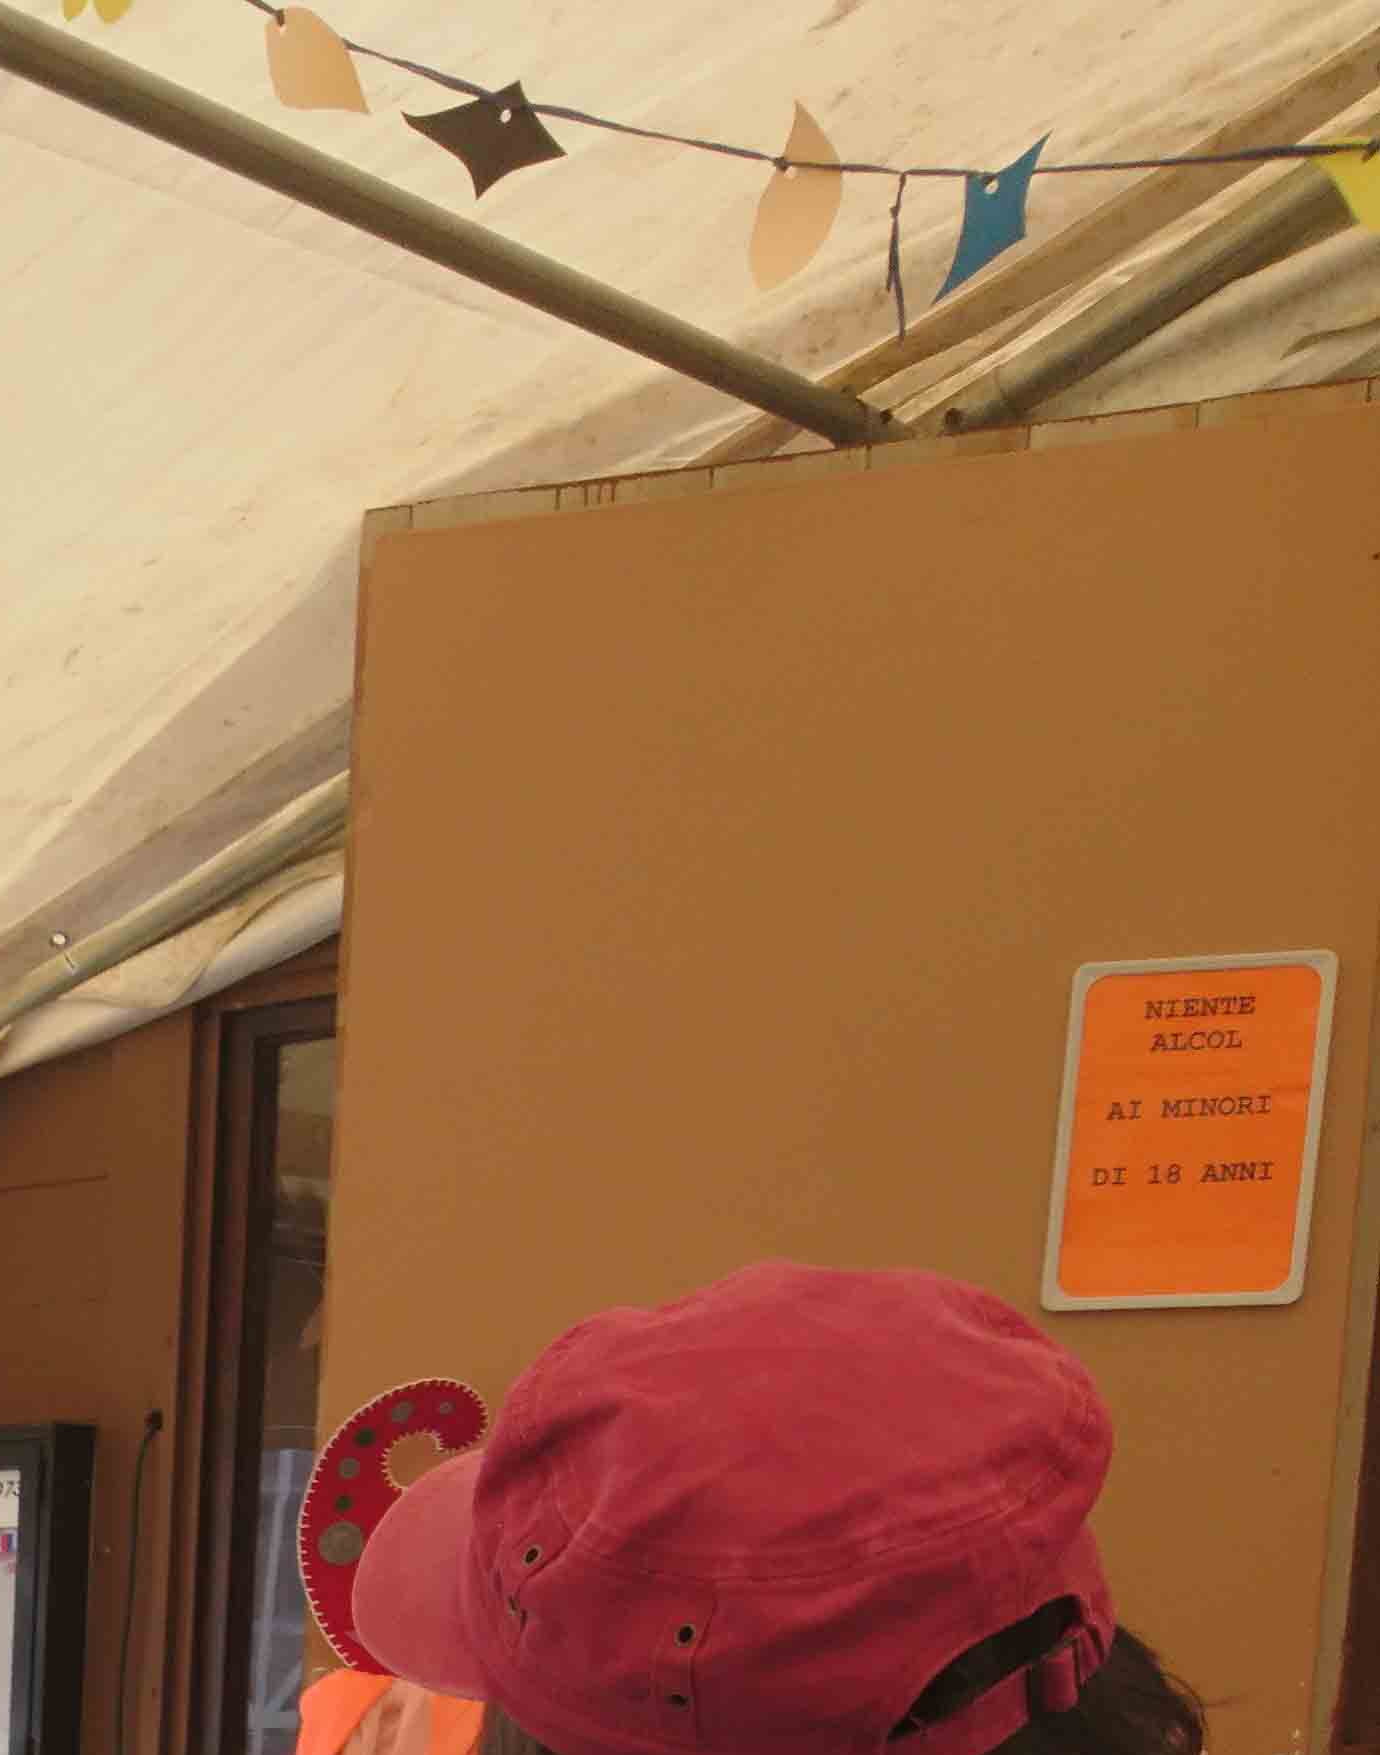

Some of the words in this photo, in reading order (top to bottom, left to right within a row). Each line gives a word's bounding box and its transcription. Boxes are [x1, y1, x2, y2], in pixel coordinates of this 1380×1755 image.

[1144, 995, 1257, 1020] NIENTE
[1150, 1029, 1243, 1053] ALCOL
[1106, 1100, 1143, 1121] AI
[1161, 1095, 1272, 1119] MINORI
[1091, 1167, 1128, 1186] DI
[1147, 1163, 1183, 1185] 18
[1200, 1160, 1275, 1184] ANNI
